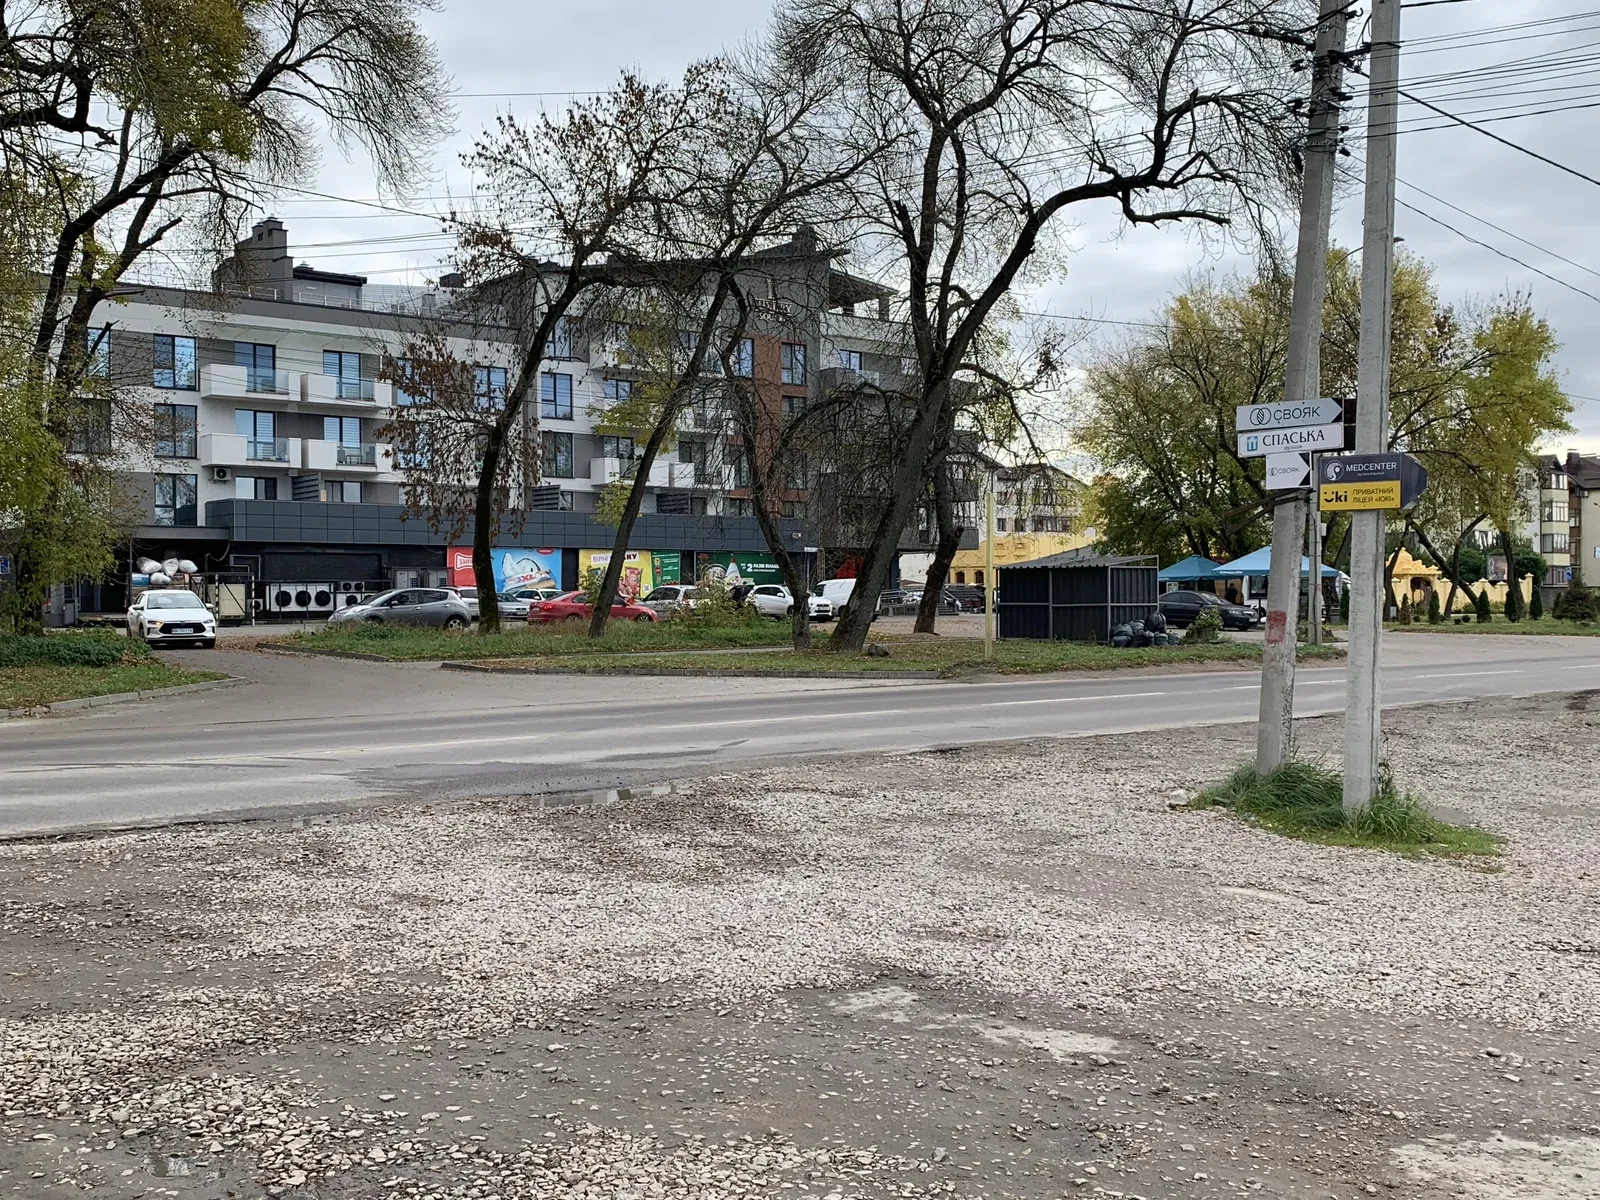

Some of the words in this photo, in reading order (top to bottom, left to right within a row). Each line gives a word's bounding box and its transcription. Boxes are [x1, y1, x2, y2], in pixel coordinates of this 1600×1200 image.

[1273, 406, 1320, 421] СВОЯК
[1262, 430, 1325, 446] СПАСЬКА
[1278, 467, 1300, 475] СВОЯК
[1346, 462, 1397, 472] MEDCENTER
[1352, 487, 1394, 496] ПРИВАТНИЙ
[1352, 496, 1373, 504] ЛІЦЕЙ
[746, 563, 752, 572] 2
